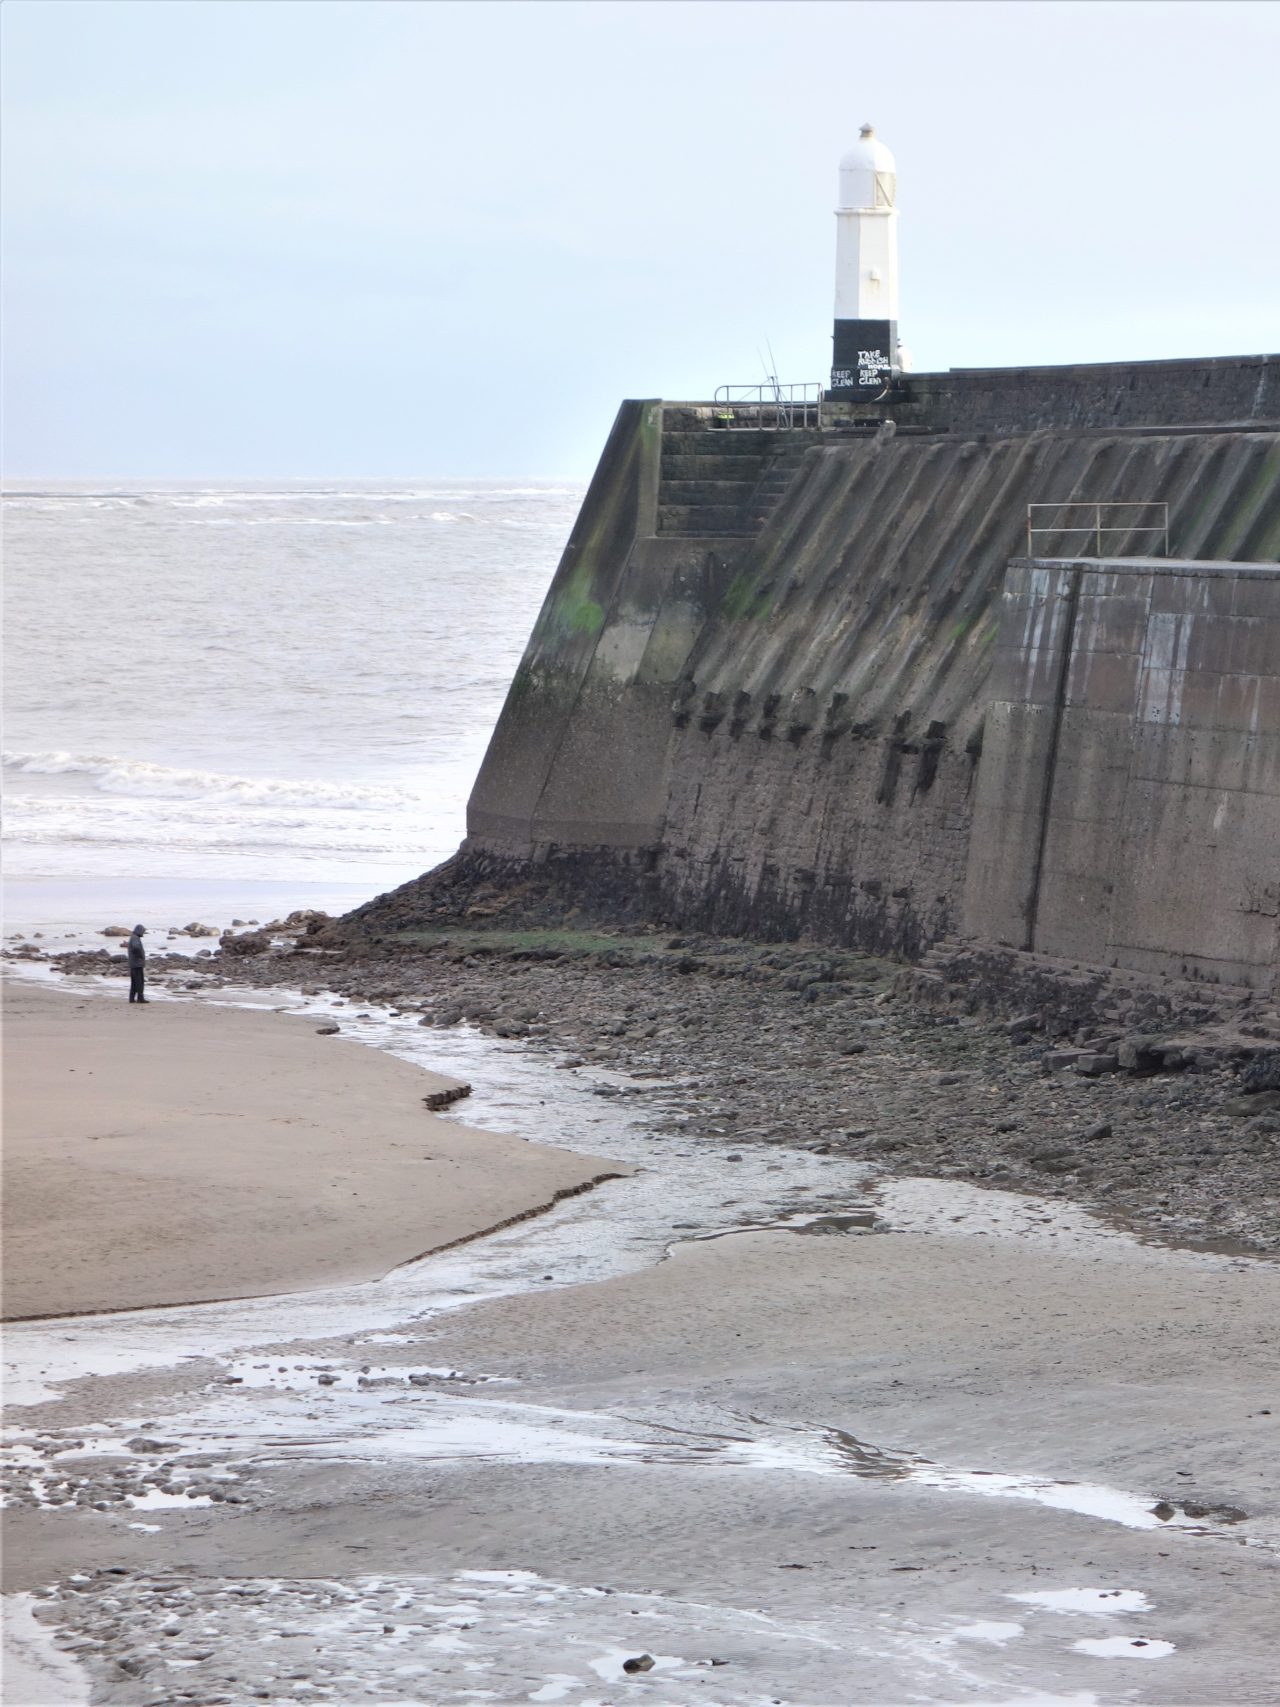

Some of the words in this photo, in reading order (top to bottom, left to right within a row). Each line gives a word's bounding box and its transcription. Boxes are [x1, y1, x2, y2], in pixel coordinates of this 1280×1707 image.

[857, 349, 880, 359] TAKE
[832, 369, 851, 377] KEEP
[860, 369, 878, 377] KEEP
